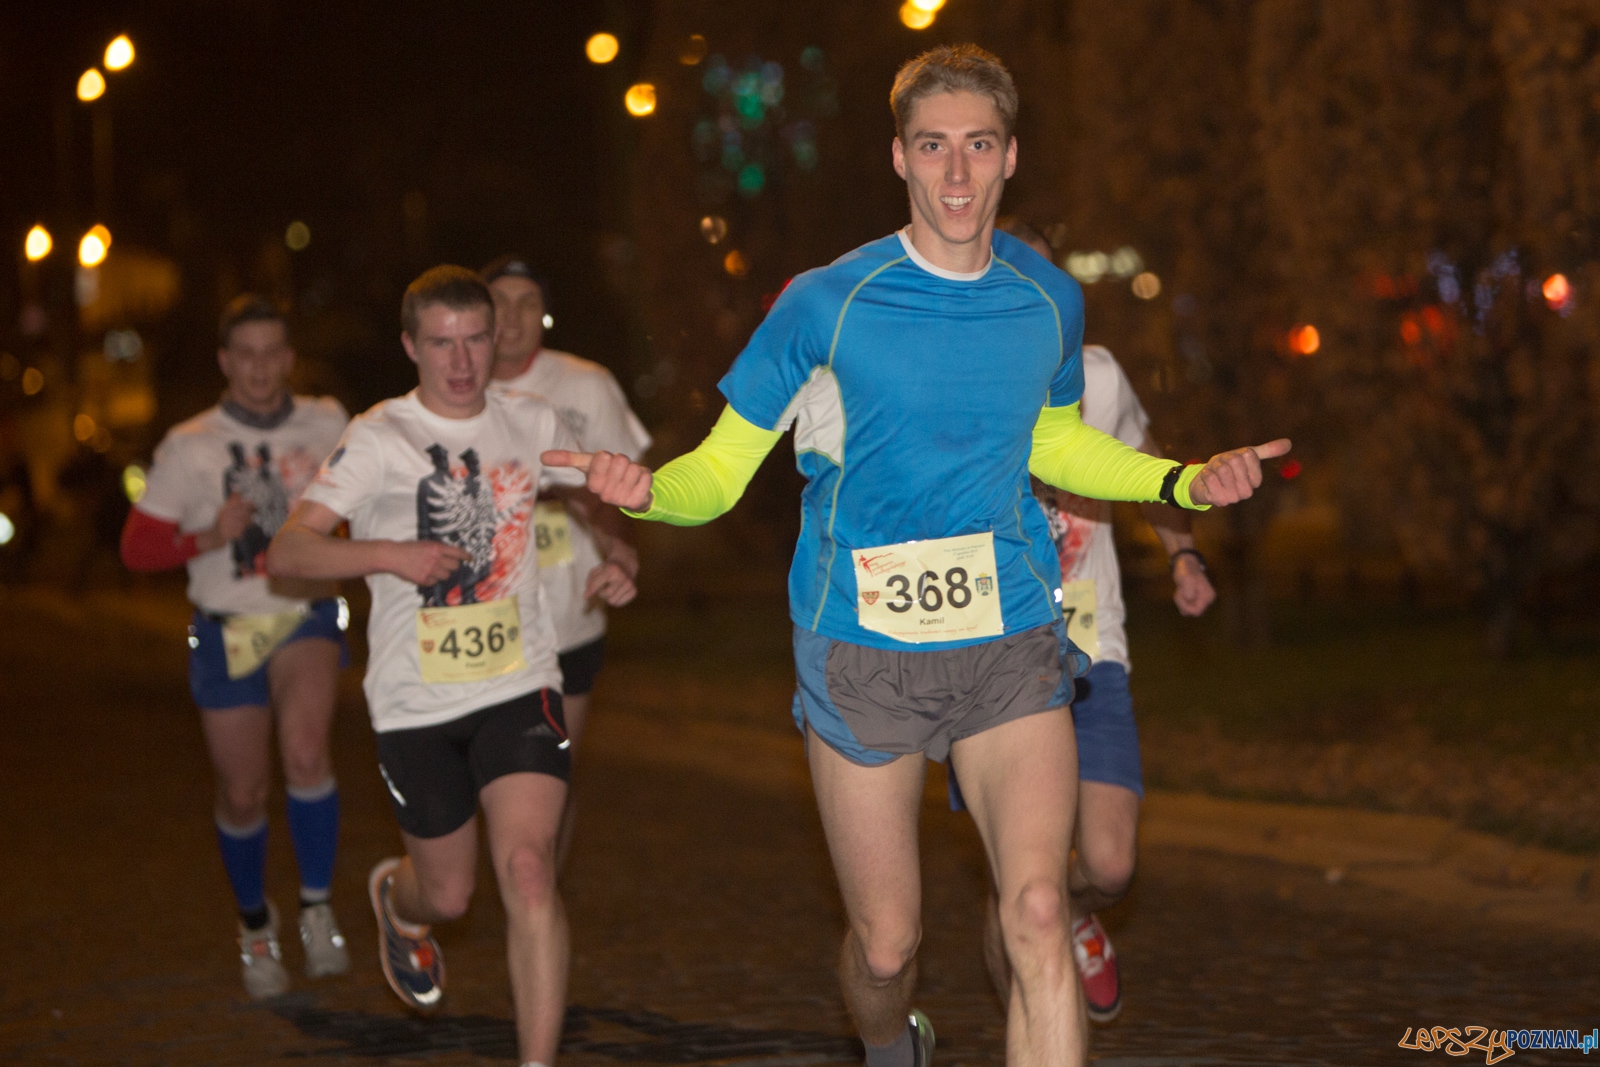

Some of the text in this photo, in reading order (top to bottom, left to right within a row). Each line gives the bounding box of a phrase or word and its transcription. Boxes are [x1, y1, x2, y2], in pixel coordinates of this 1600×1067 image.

[886, 567, 972, 613] 368
[919, 617, 945, 626] Kamil
[439, 622, 505, 659] 436
